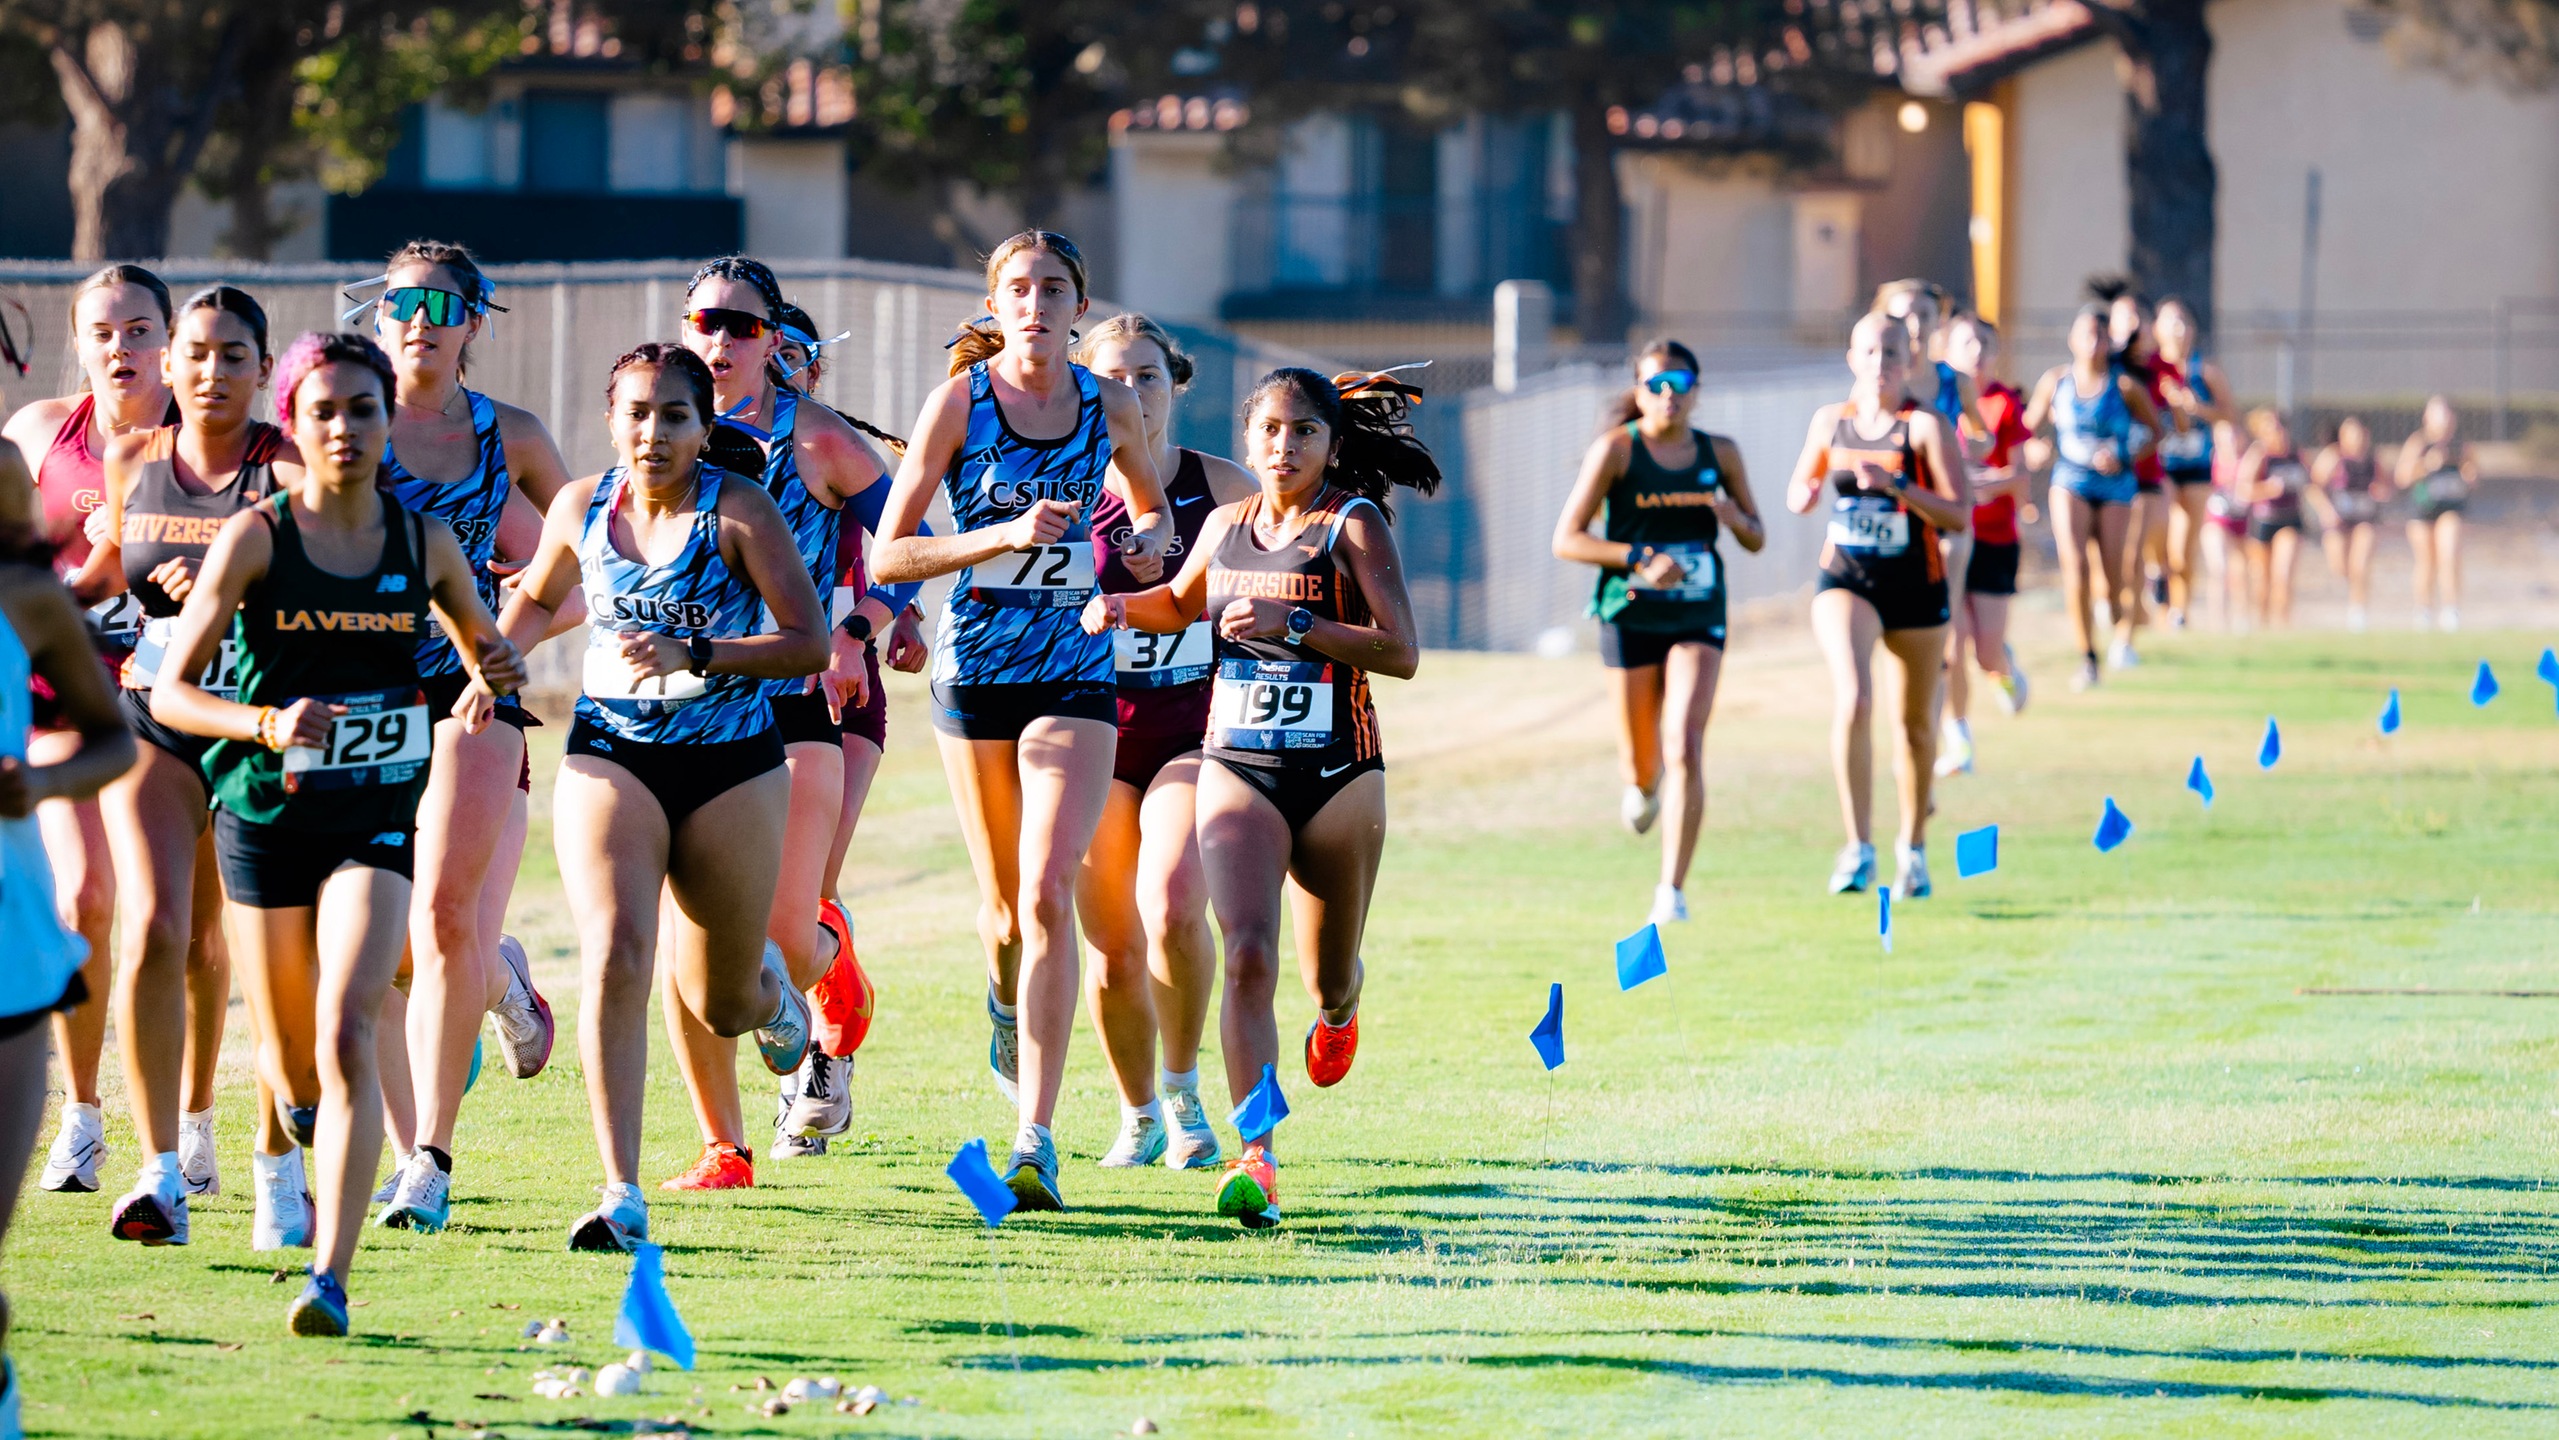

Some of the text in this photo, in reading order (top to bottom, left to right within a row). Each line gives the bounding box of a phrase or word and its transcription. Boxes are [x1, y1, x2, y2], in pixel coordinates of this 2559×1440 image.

[987, 480, 1097, 509] CSUSB
[123, 513, 231, 545] RIVERS
[1010, 546, 1071, 586] 72
[1206, 568, 1323, 601] RIVERSIDE
[276, 610, 415, 632] LA VERNE
[591, 593, 710, 629] CSUSB
[1131, 629, 1186, 669] 37
[1254, 673, 1289, 681] RESULTS
[1239, 683, 1313, 726] 199
[323, 713, 407, 766] 129
